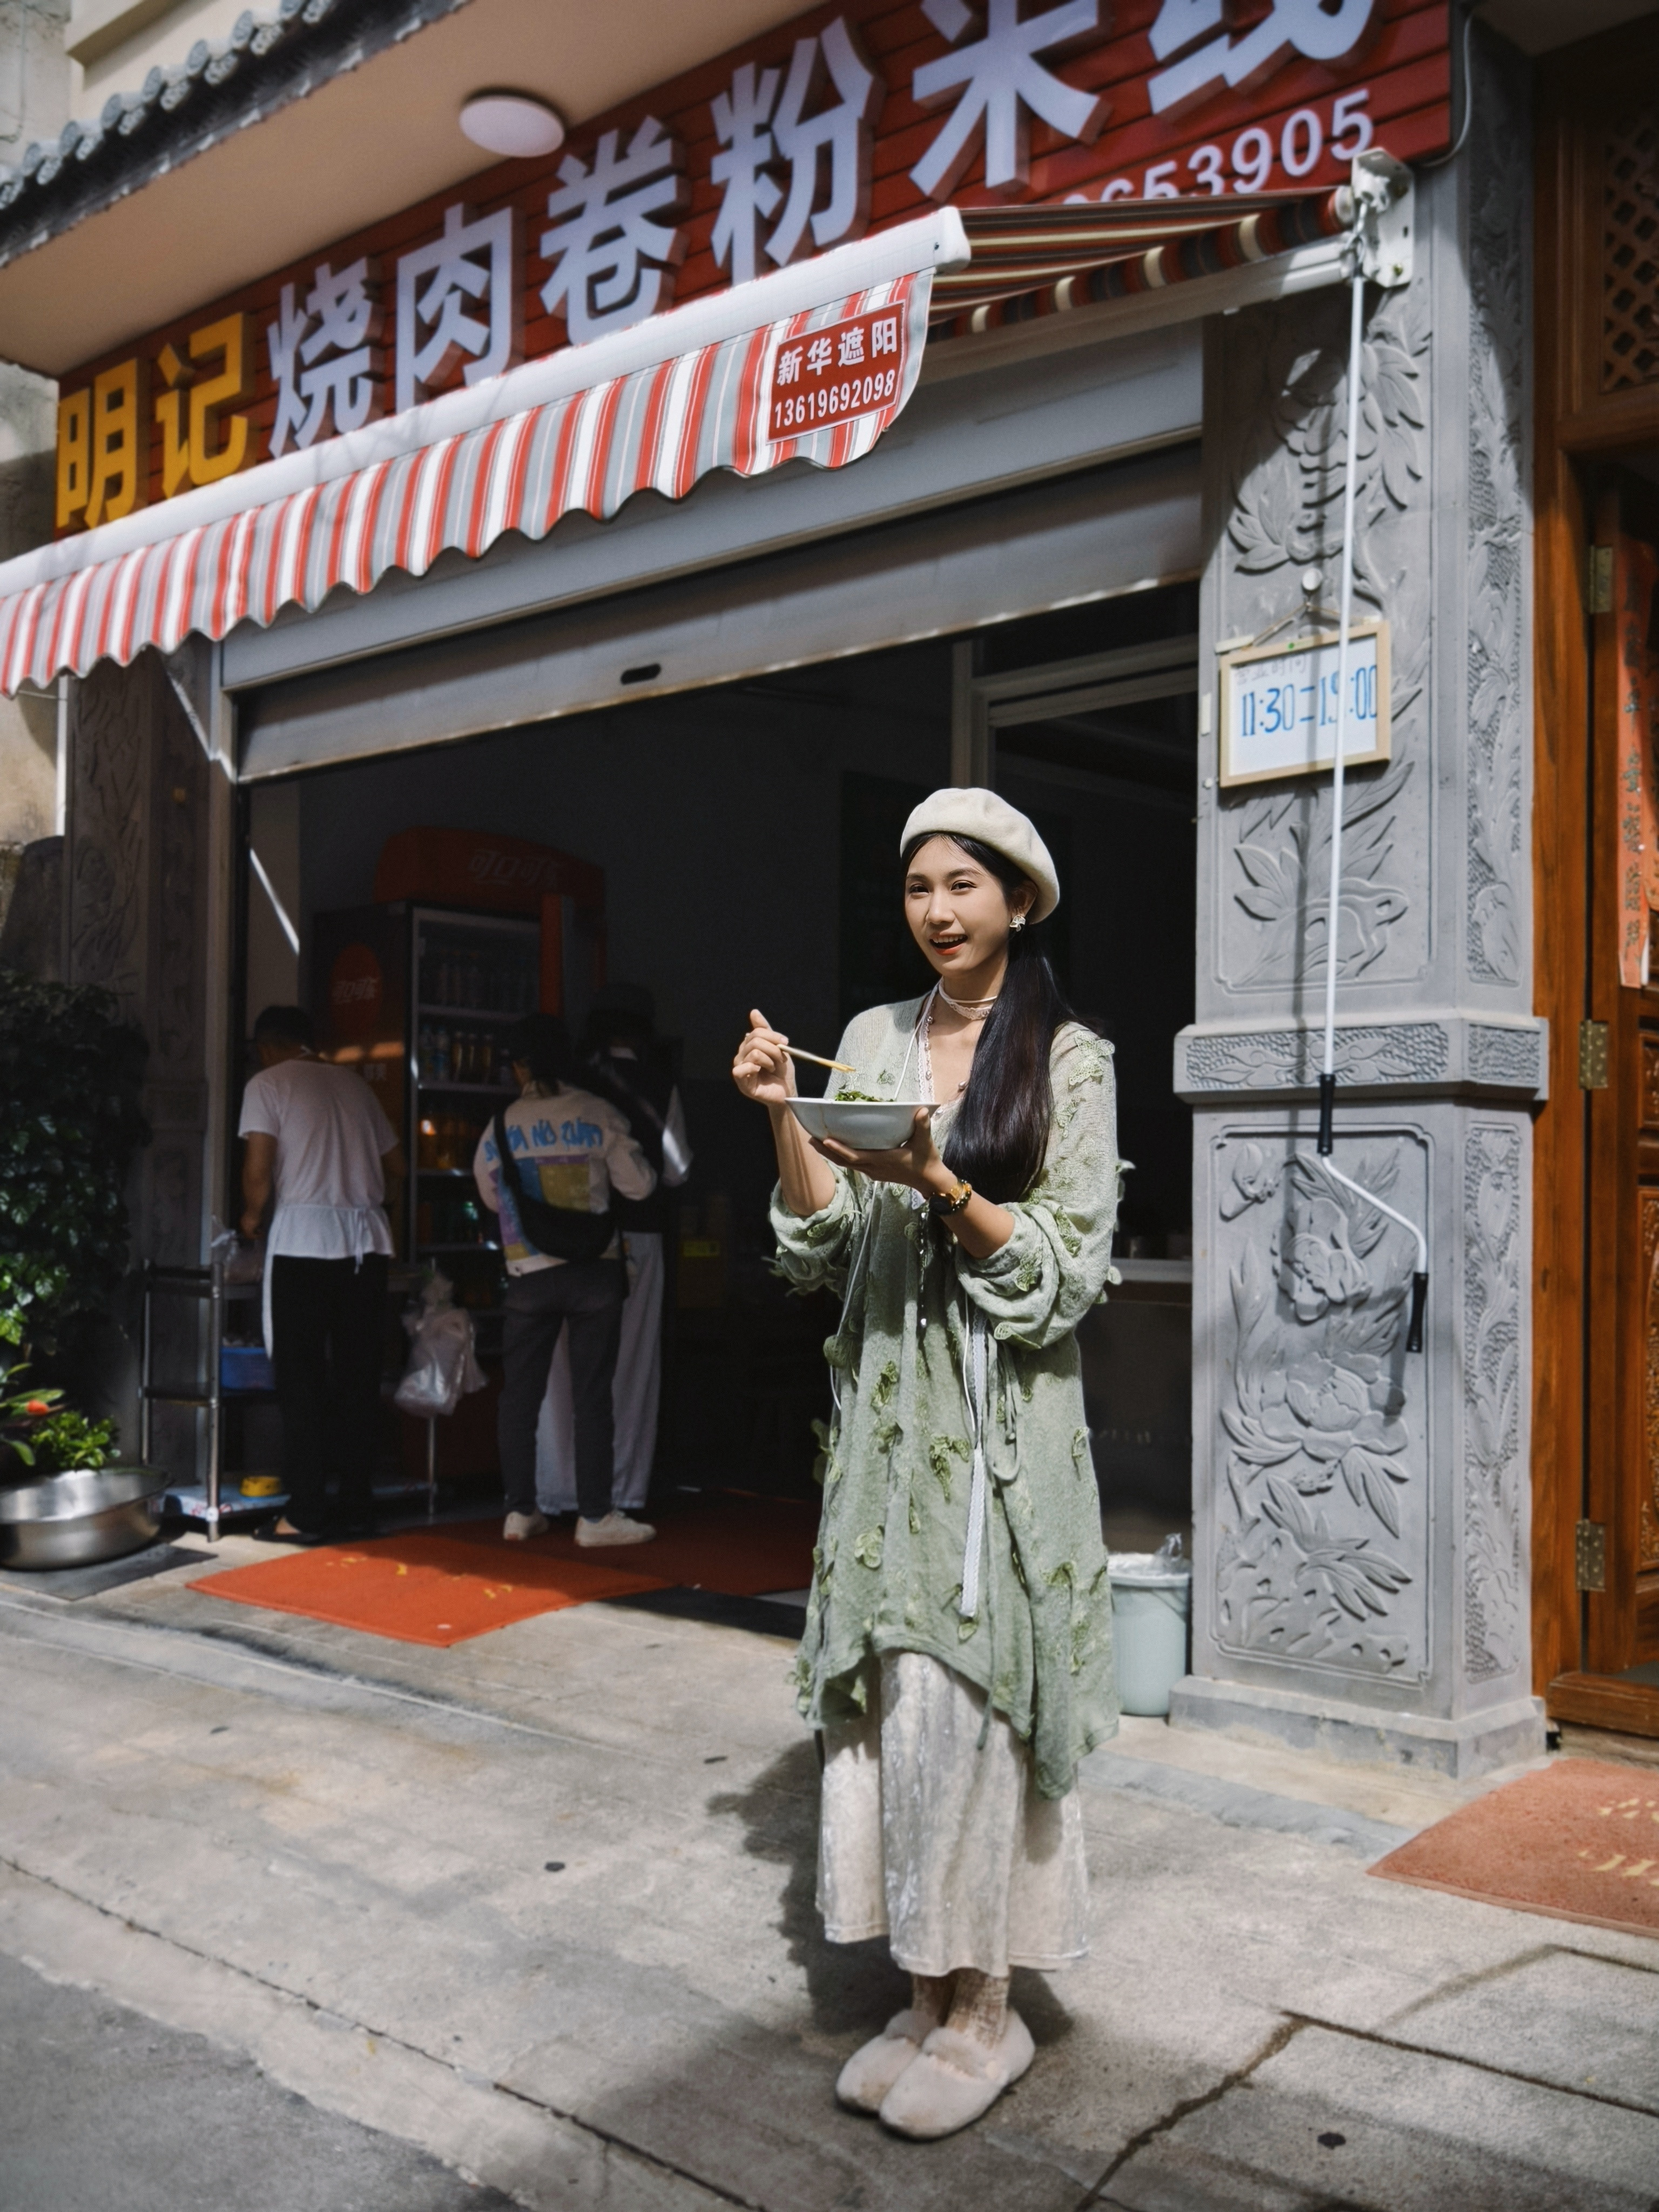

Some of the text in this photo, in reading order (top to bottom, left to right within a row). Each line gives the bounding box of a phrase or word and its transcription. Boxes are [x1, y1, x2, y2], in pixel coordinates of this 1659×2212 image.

[1062, 88, 1374, 205] 53905
[777, 316, 898, 387] 新华遮阳
[774, 369, 896, 429] 13619692098
